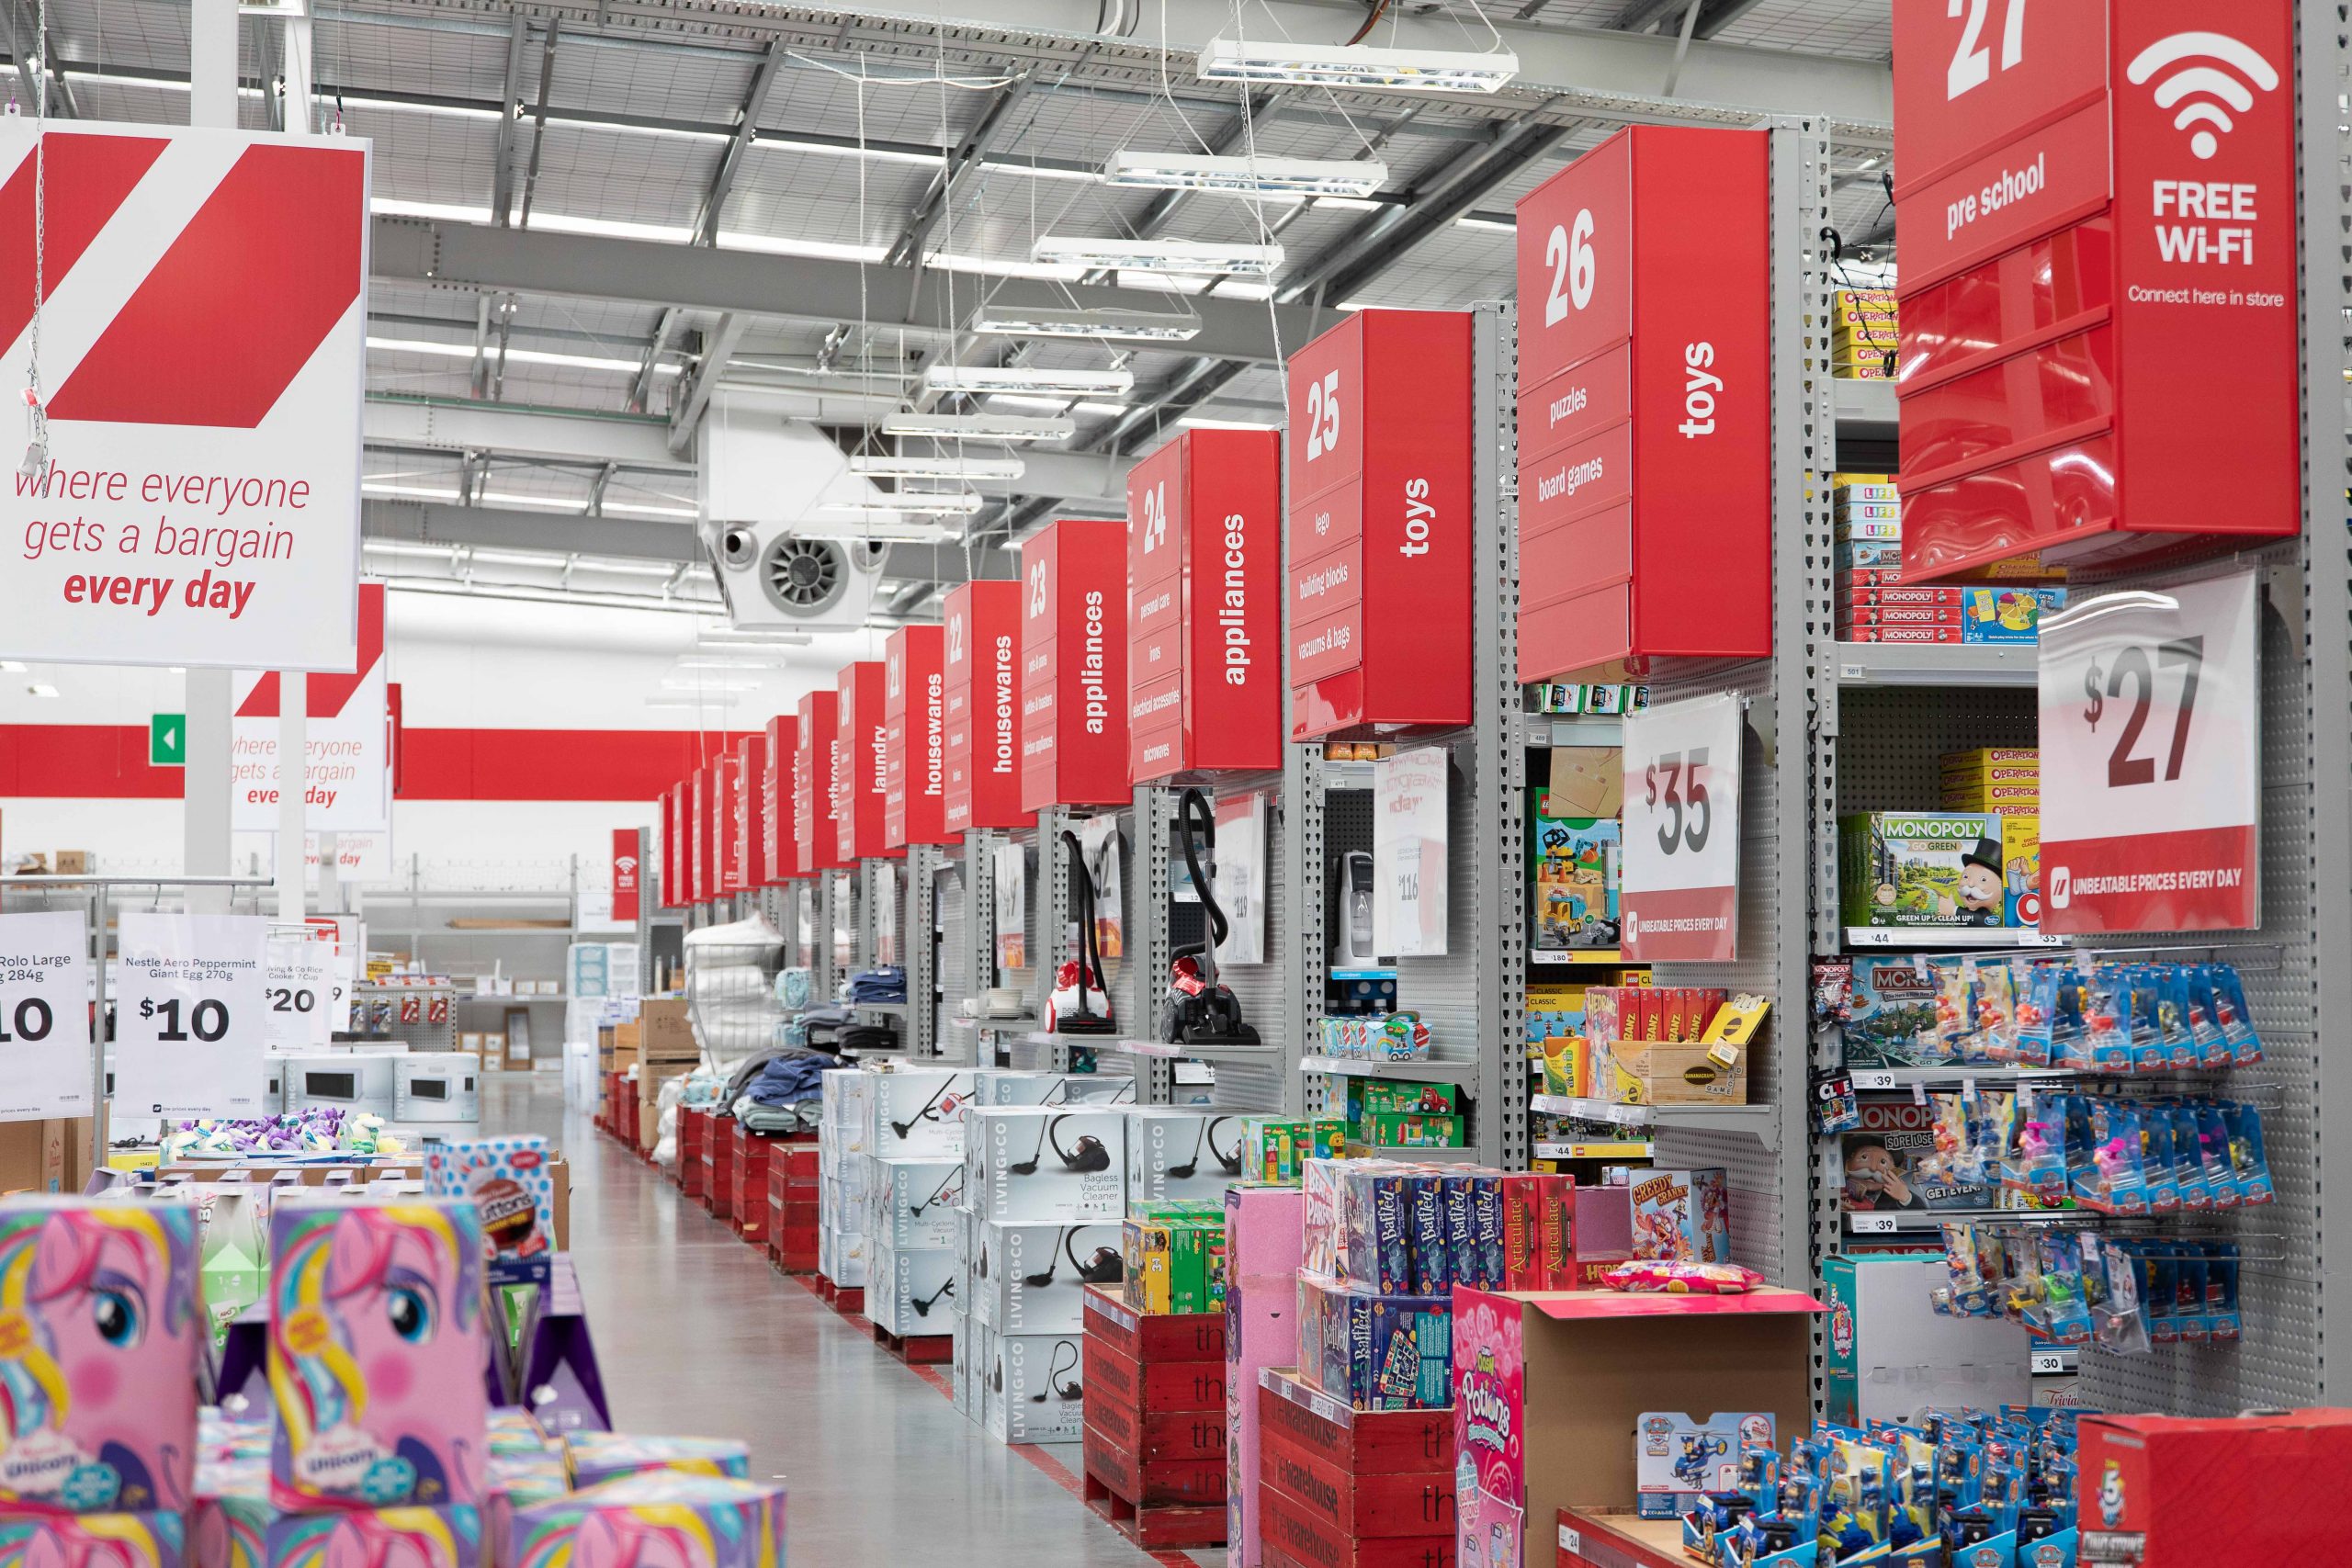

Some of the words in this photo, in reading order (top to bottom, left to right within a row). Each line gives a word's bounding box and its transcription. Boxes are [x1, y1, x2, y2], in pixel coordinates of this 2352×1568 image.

[1947, 195, 1977, 241] pre
[1981, 152, 2046, 217] school
[2153, 179, 2257, 220] FREE
[2154, 224, 2254, 265] Wi-Fi
[1545, 208, 1595, 329] 26
[2127, 285, 2190, 306] Connect
[2197, 288, 2227, 307] here
[2229, 288, 2244, 307] in
[2245, 291, 2285, 308] store
[1550, 384, 1588, 429] puzzles
[1679, 341, 1724, 439] toys
[1307, 368, 1340, 462] 25
[16, 459, 128, 502] where
[141, 474, 311, 515] everyone
[1538, 471, 1566, 503] board
[1567, 456, 1603, 496] games
[1864, 487, 1895, 500] LIFE
[1144, 480, 1167, 555] 24
[1315, 512, 1330, 536] lego
[1399, 478, 1436, 558] toys
[1865, 505, 1896, 518] LIFE
[23, 516, 105, 560] gets
[119, 525, 141, 554] a
[154, 514, 294, 567] bargain
[1866, 524, 1897, 536] LIFE
[63, 573, 175, 616] every
[185, 569, 256, 620] day
[1030, 558, 1046, 619] 23
[1299, 571, 1325, 601] building
[1326, 561, 1348, 589] blocks
[1884, 591, 1933, 602] MONOPOLY
[1218, 513, 1251, 685] appliances
[1884, 610, 1933, 621] MONOPOLY
[949, 613, 963, 664] 22
[1298, 635, 1326, 660] vacuums
[1327, 627, 1332, 649] &
[1333, 625, 1351, 649] bags
[1884, 630, 1933, 640] MONOPOLY
[1080, 591, 1108, 735] appliances
[992, 635, 1012, 773] housewares
[2083, 635, 2204, 788] $27
[304, 739, 363, 760] eryone
[924, 672, 943, 795] housewares
[304, 763, 356, 784] argain
[872, 725, 887, 794] laundry
[247, 788, 280, 805] eve
[304, 786, 337, 808] day
[1645, 746, 1711, 856] $35
[1886, 820, 1984, 839] MONOPOLY
[1928, 842, 1958, 851] GREEN
[2073, 875, 2139, 897] UNBEATABLE
[2138, 872, 2177, 892] PRICES
[2178, 869, 2215, 889] EVERY
[2217, 867, 2242, 887] DAY
[1638, 920, 1674, 933] UNBEATABLE
[1673, 919, 1694, 932] PRICES
[1695, 918, 1713, 931] EVERY
[1714, 917, 1728, 930] DAY
[1895, 914, 1920, 922] GREEN
[1921, 914, 1930, 922] UP
[1938, 914, 1961, 922] CLEAN
[1962, 914, 1974, 922] UP!
[1871, 933, 1890, 943] $44
[8, 969, 44, 983] 284g
[33, 954, 72, 968] Large
[126, 957, 161, 967] Nestle
[164, 958, 189, 968] Aero
[193, 958, 256, 970] Peppermint
[149, 968, 178, 979] Giant
[182, 969, 203, 981] Egg
[206, 970, 233, 982] 270g
[303, 974, 319, 982] Cup
[265, 987, 315, 1013] $20
[140, 996, 230, 1043] $10
[1623, 1012, 1636, 1042] BANZ
[1645, 1013, 1659, 1042] BANZ
[1668, 1013, 1681, 1042] BANZ
[1689, 1013, 1702, 1042] BANZ
[1706, 1085, 1732, 1094] GAME
[1819, 1079, 1851, 1100] CLUE
[1873, 1076, 1892, 1086] $39
[879, 1080, 890, 1153] LIVING&CO
[1887, 1135, 1911, 1148] SORE
[996, 1122, 1008, 1215] LIVING&CO
[1084, 1174, 1118, 1184] Bagless
[1080, 1183, 1119, 1191] Vacuum
[1082, 1192, 1118, 1201] Cleaner
[1632, 1174, 1673, 1206] GREEDY
[1657, 1185, 1689, 1207] GRANNY
[1926, 1188, 1948, 1200] GET
[898, 1170, 909, 1246] LIVING&CO
[1378, 1190, 1397, 1243] Baffled
[1417, 1190, 1436, 1243] Baffled
[1449, 1190, 1467, 1242] Baffled
[1477, 1190, 1495, 1242] Baffled
[1875, 1219, 1894, 1230] $39
[1509, 1197, 1523, 1273] Articulate!
[1544, 1196, 1560, 1273] Articulate!
[899, 1257, 910, 1331] LIVING&CO
[1011, 1233, 1023, 1329] LIVING&CO
[1322, 1313, 1350, 1354] Baffled
[1351, 1308, 1372, 1361] Baffled
[2040, 1358, 2059, 1369] $30
[1012, 1341, 1025, 1438] LIVING&CO
[1463, 1371, 1510, 1438] Potions
